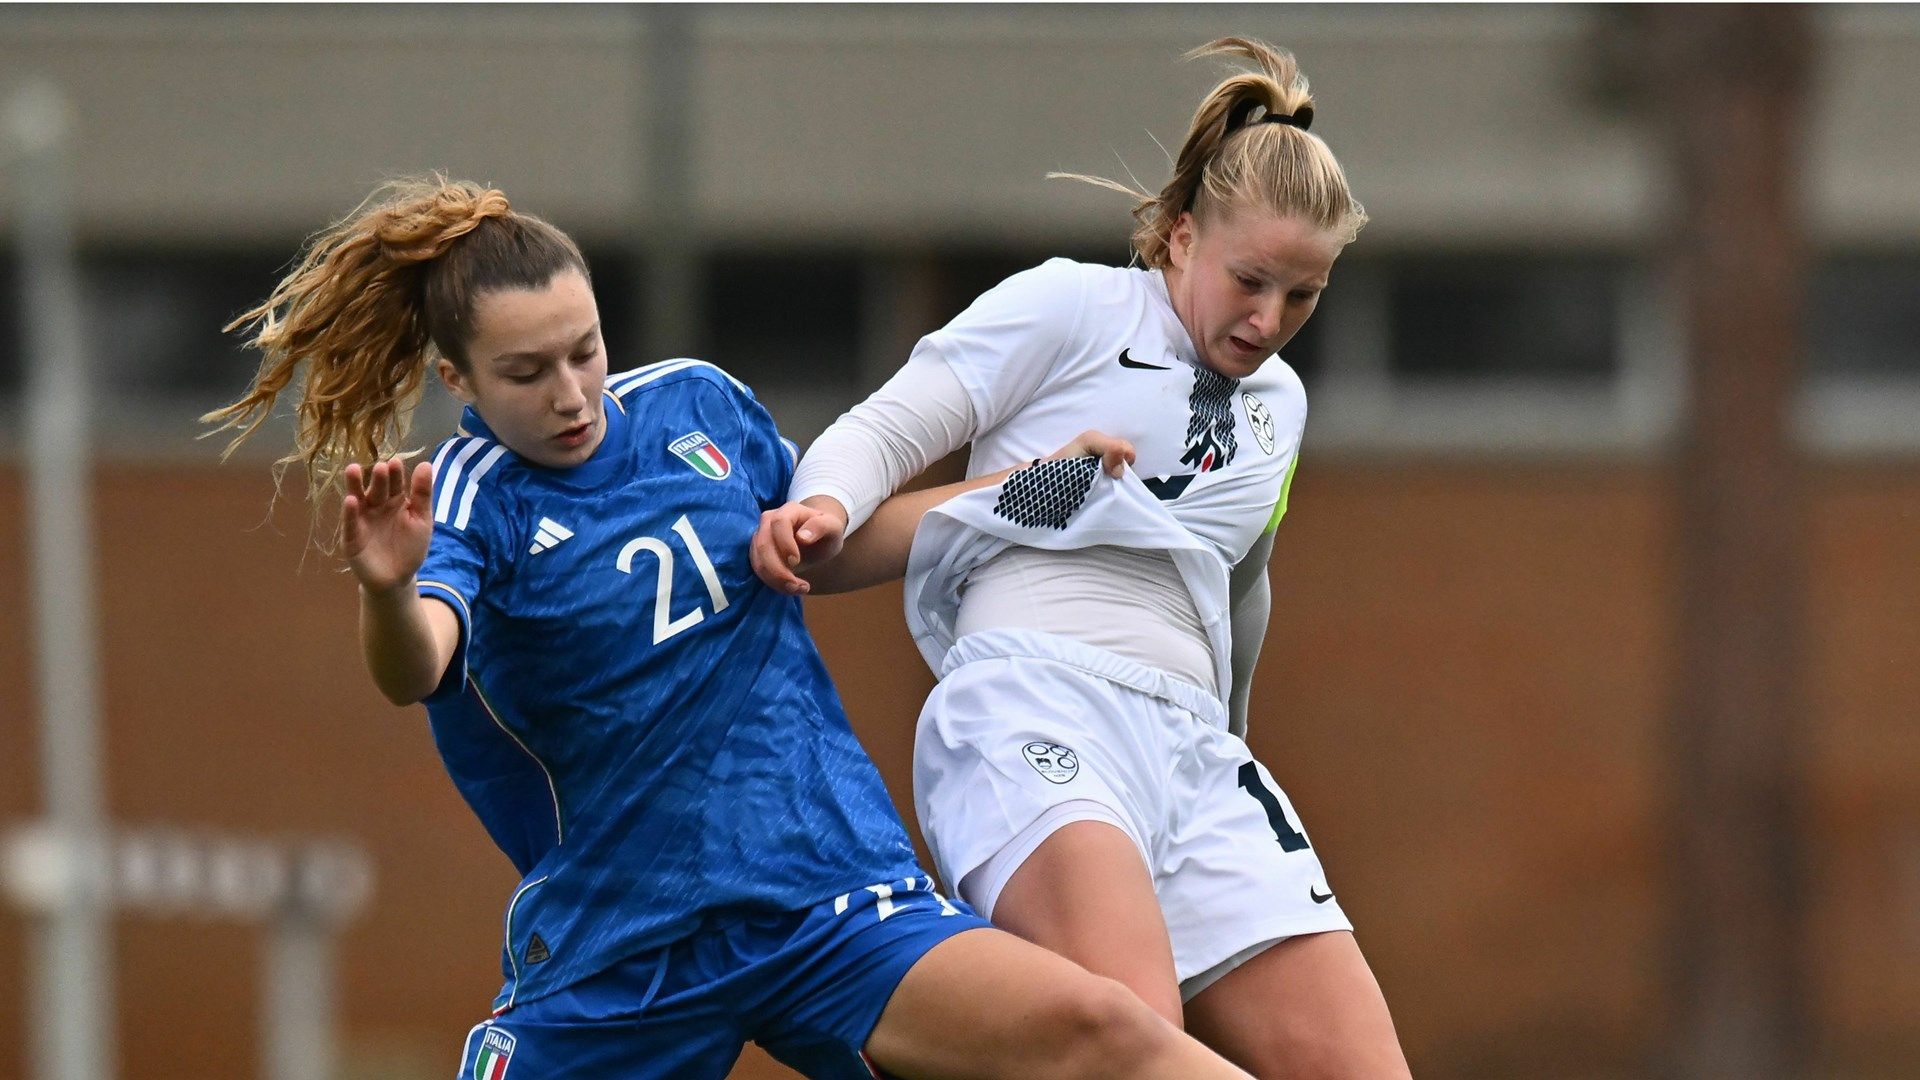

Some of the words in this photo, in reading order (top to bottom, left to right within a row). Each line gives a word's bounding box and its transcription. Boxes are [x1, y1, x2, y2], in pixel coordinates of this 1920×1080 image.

[672, 434, 706, 454] ITALIA
[616, 514, 730, 646] 21
[1238, 760, 1310, 853] 1
[486, 1031, 512, 1053] ITALIA
